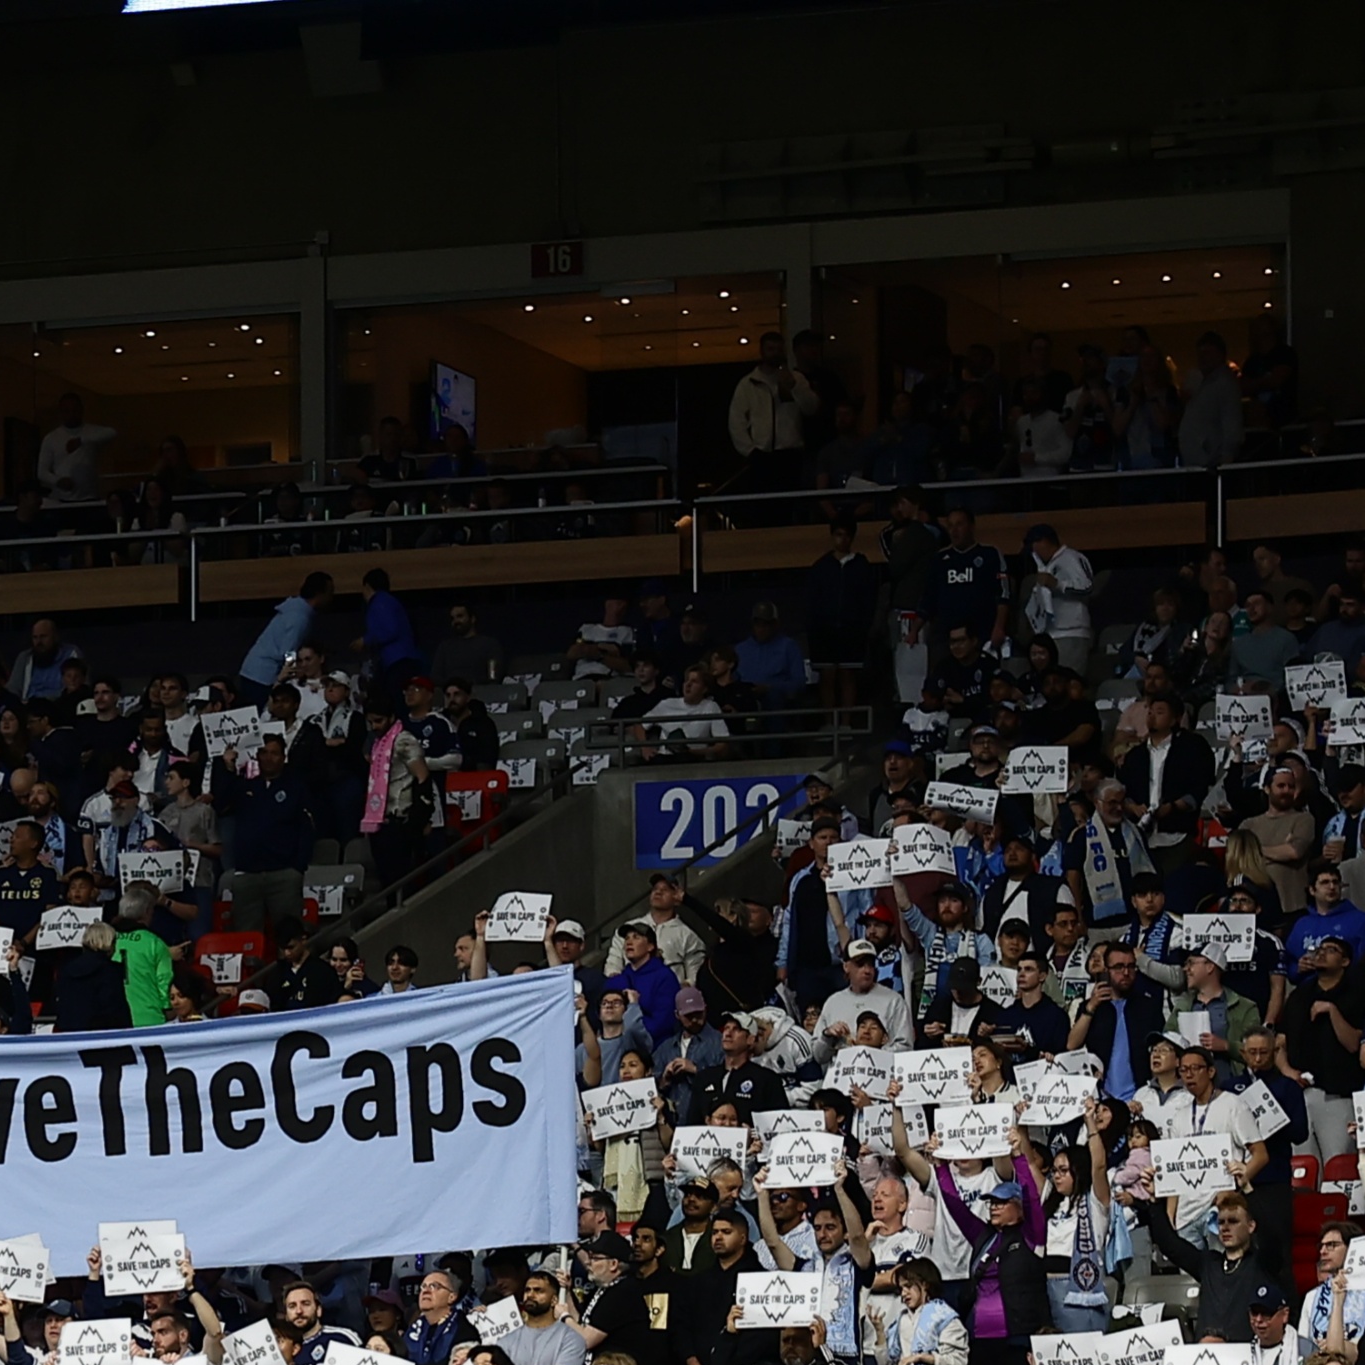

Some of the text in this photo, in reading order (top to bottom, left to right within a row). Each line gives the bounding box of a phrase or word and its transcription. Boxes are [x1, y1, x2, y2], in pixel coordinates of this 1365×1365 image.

[947, 566, 973, 583] Bell
[659, 782, 780, 860] 202
[1, 889, 40, 900] TELUS
[908, 1072, 926, 1083] SAVE
[938, 1070, 958, 1081] CAPS
[1166, 1158, 1217, 1173] SAVE THE CAPS
